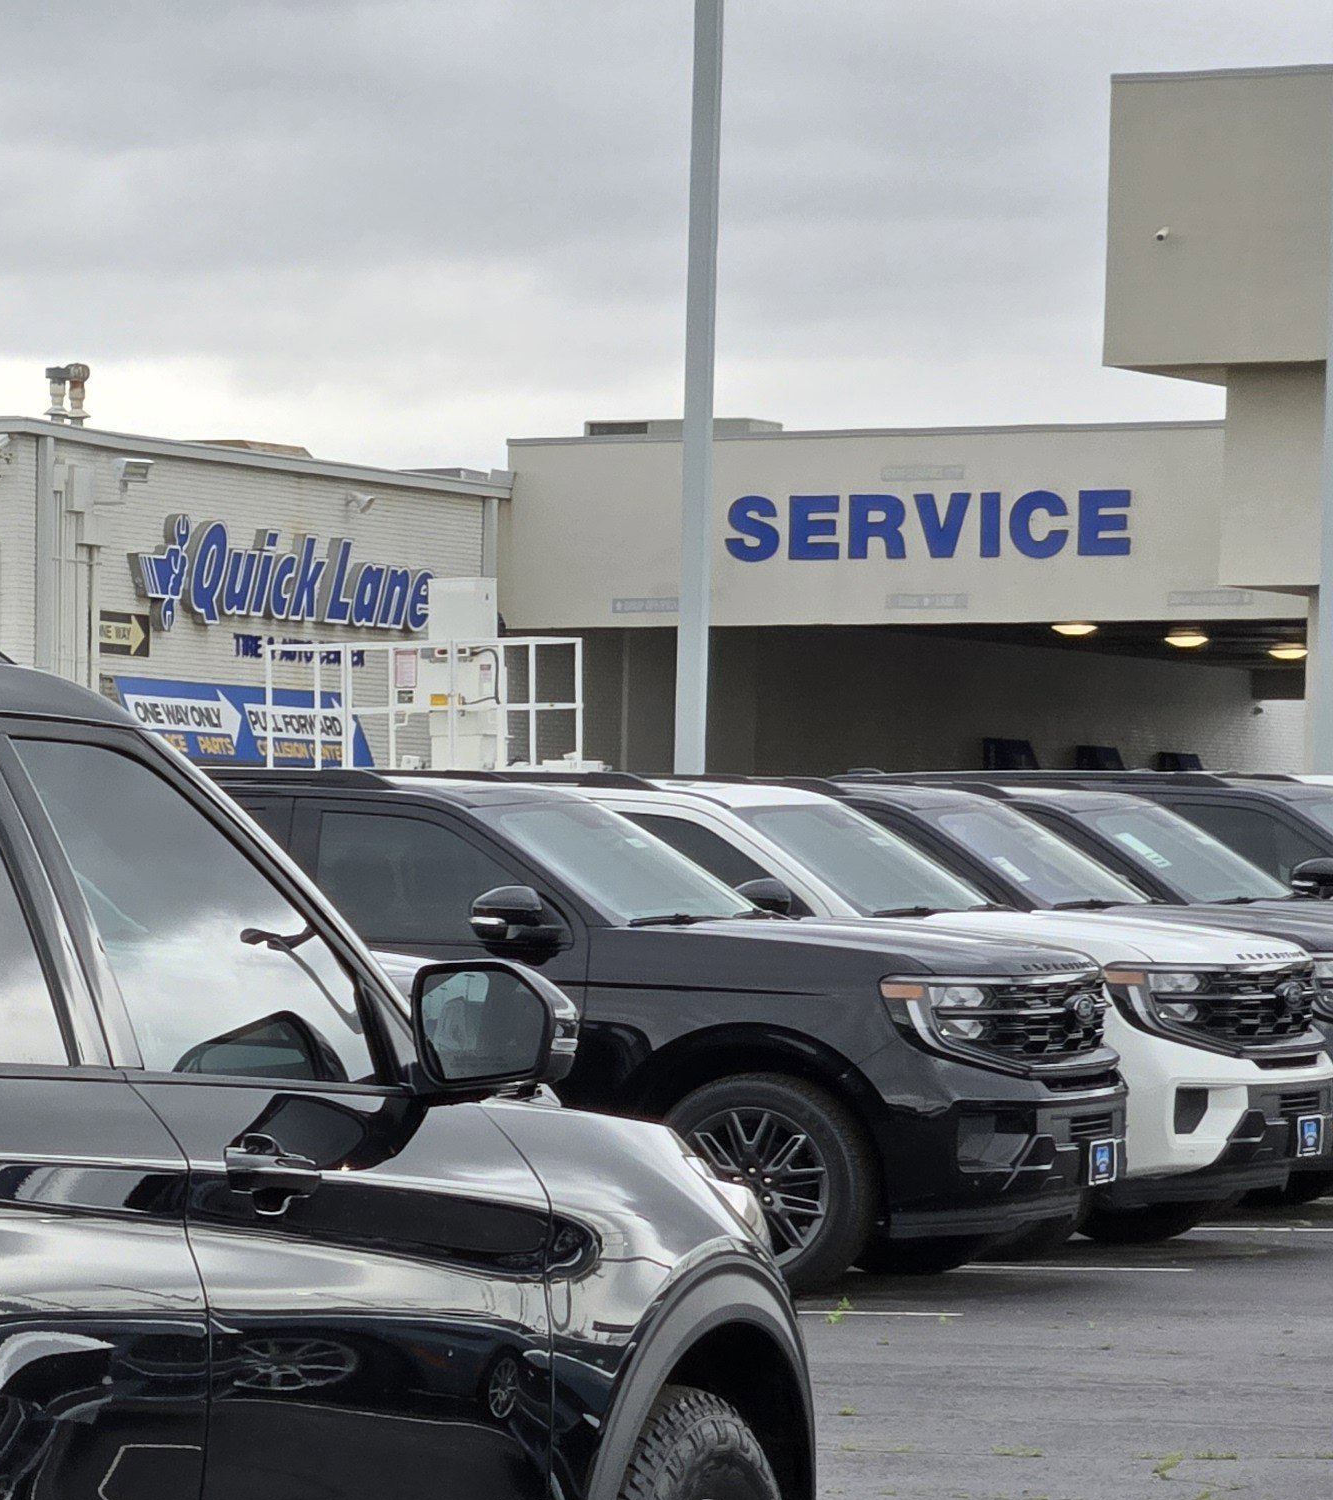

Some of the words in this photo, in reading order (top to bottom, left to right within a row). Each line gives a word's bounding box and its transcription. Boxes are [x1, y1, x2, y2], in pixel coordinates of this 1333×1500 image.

[724, 490, 1131, 562] SERVICE
[190, 520, 329, 624] Quick
[324, 537, 433, 632] Lane
[99, 624, 112, 639] NE
[114, 626, 132, 640] WAY
[233, 632, 262, 658] TIRE
[134, 701, 164, 724] ONE
[160, 703, 191, 726] WAY
[189, 705, 222, 728] ONLY
[247, 710, 283, 732] PUL
[196, 735, 235, 756] PARTS
